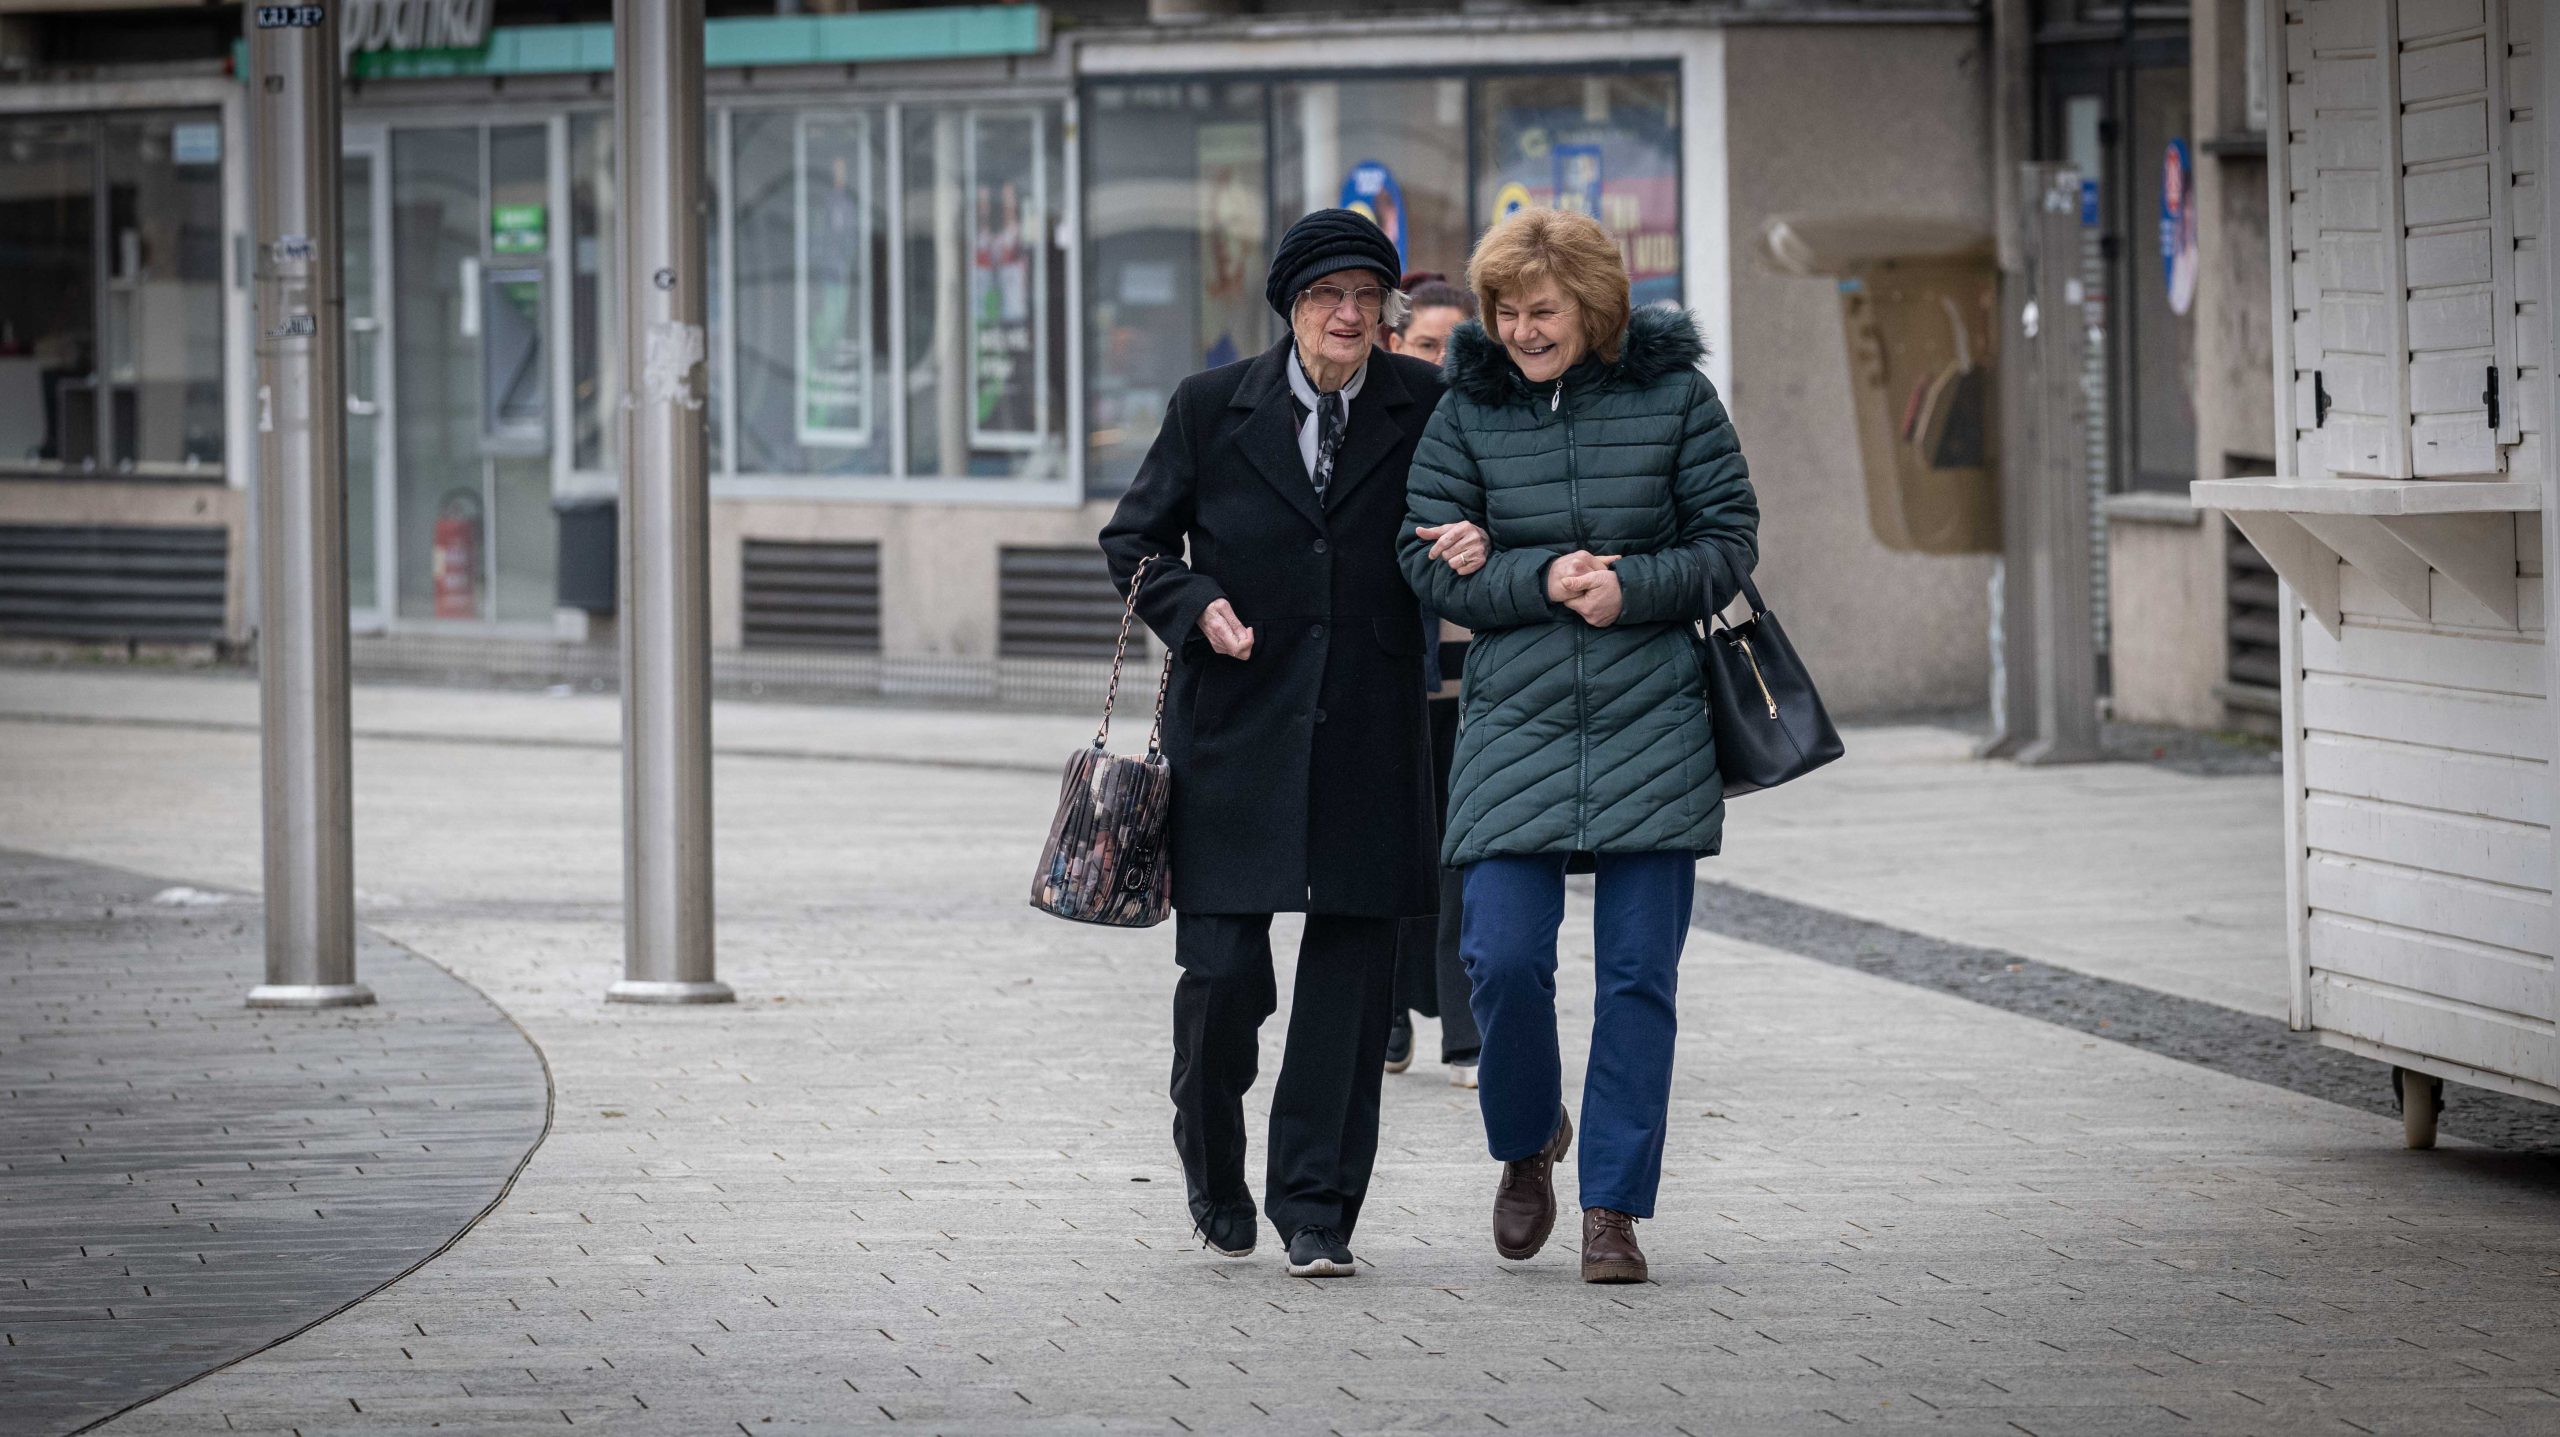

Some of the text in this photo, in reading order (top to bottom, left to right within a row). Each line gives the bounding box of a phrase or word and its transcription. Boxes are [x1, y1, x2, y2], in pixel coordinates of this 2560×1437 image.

[258, 6, 323, 27] KAJ JE?
[338, 0, 488, 79] pbanka
